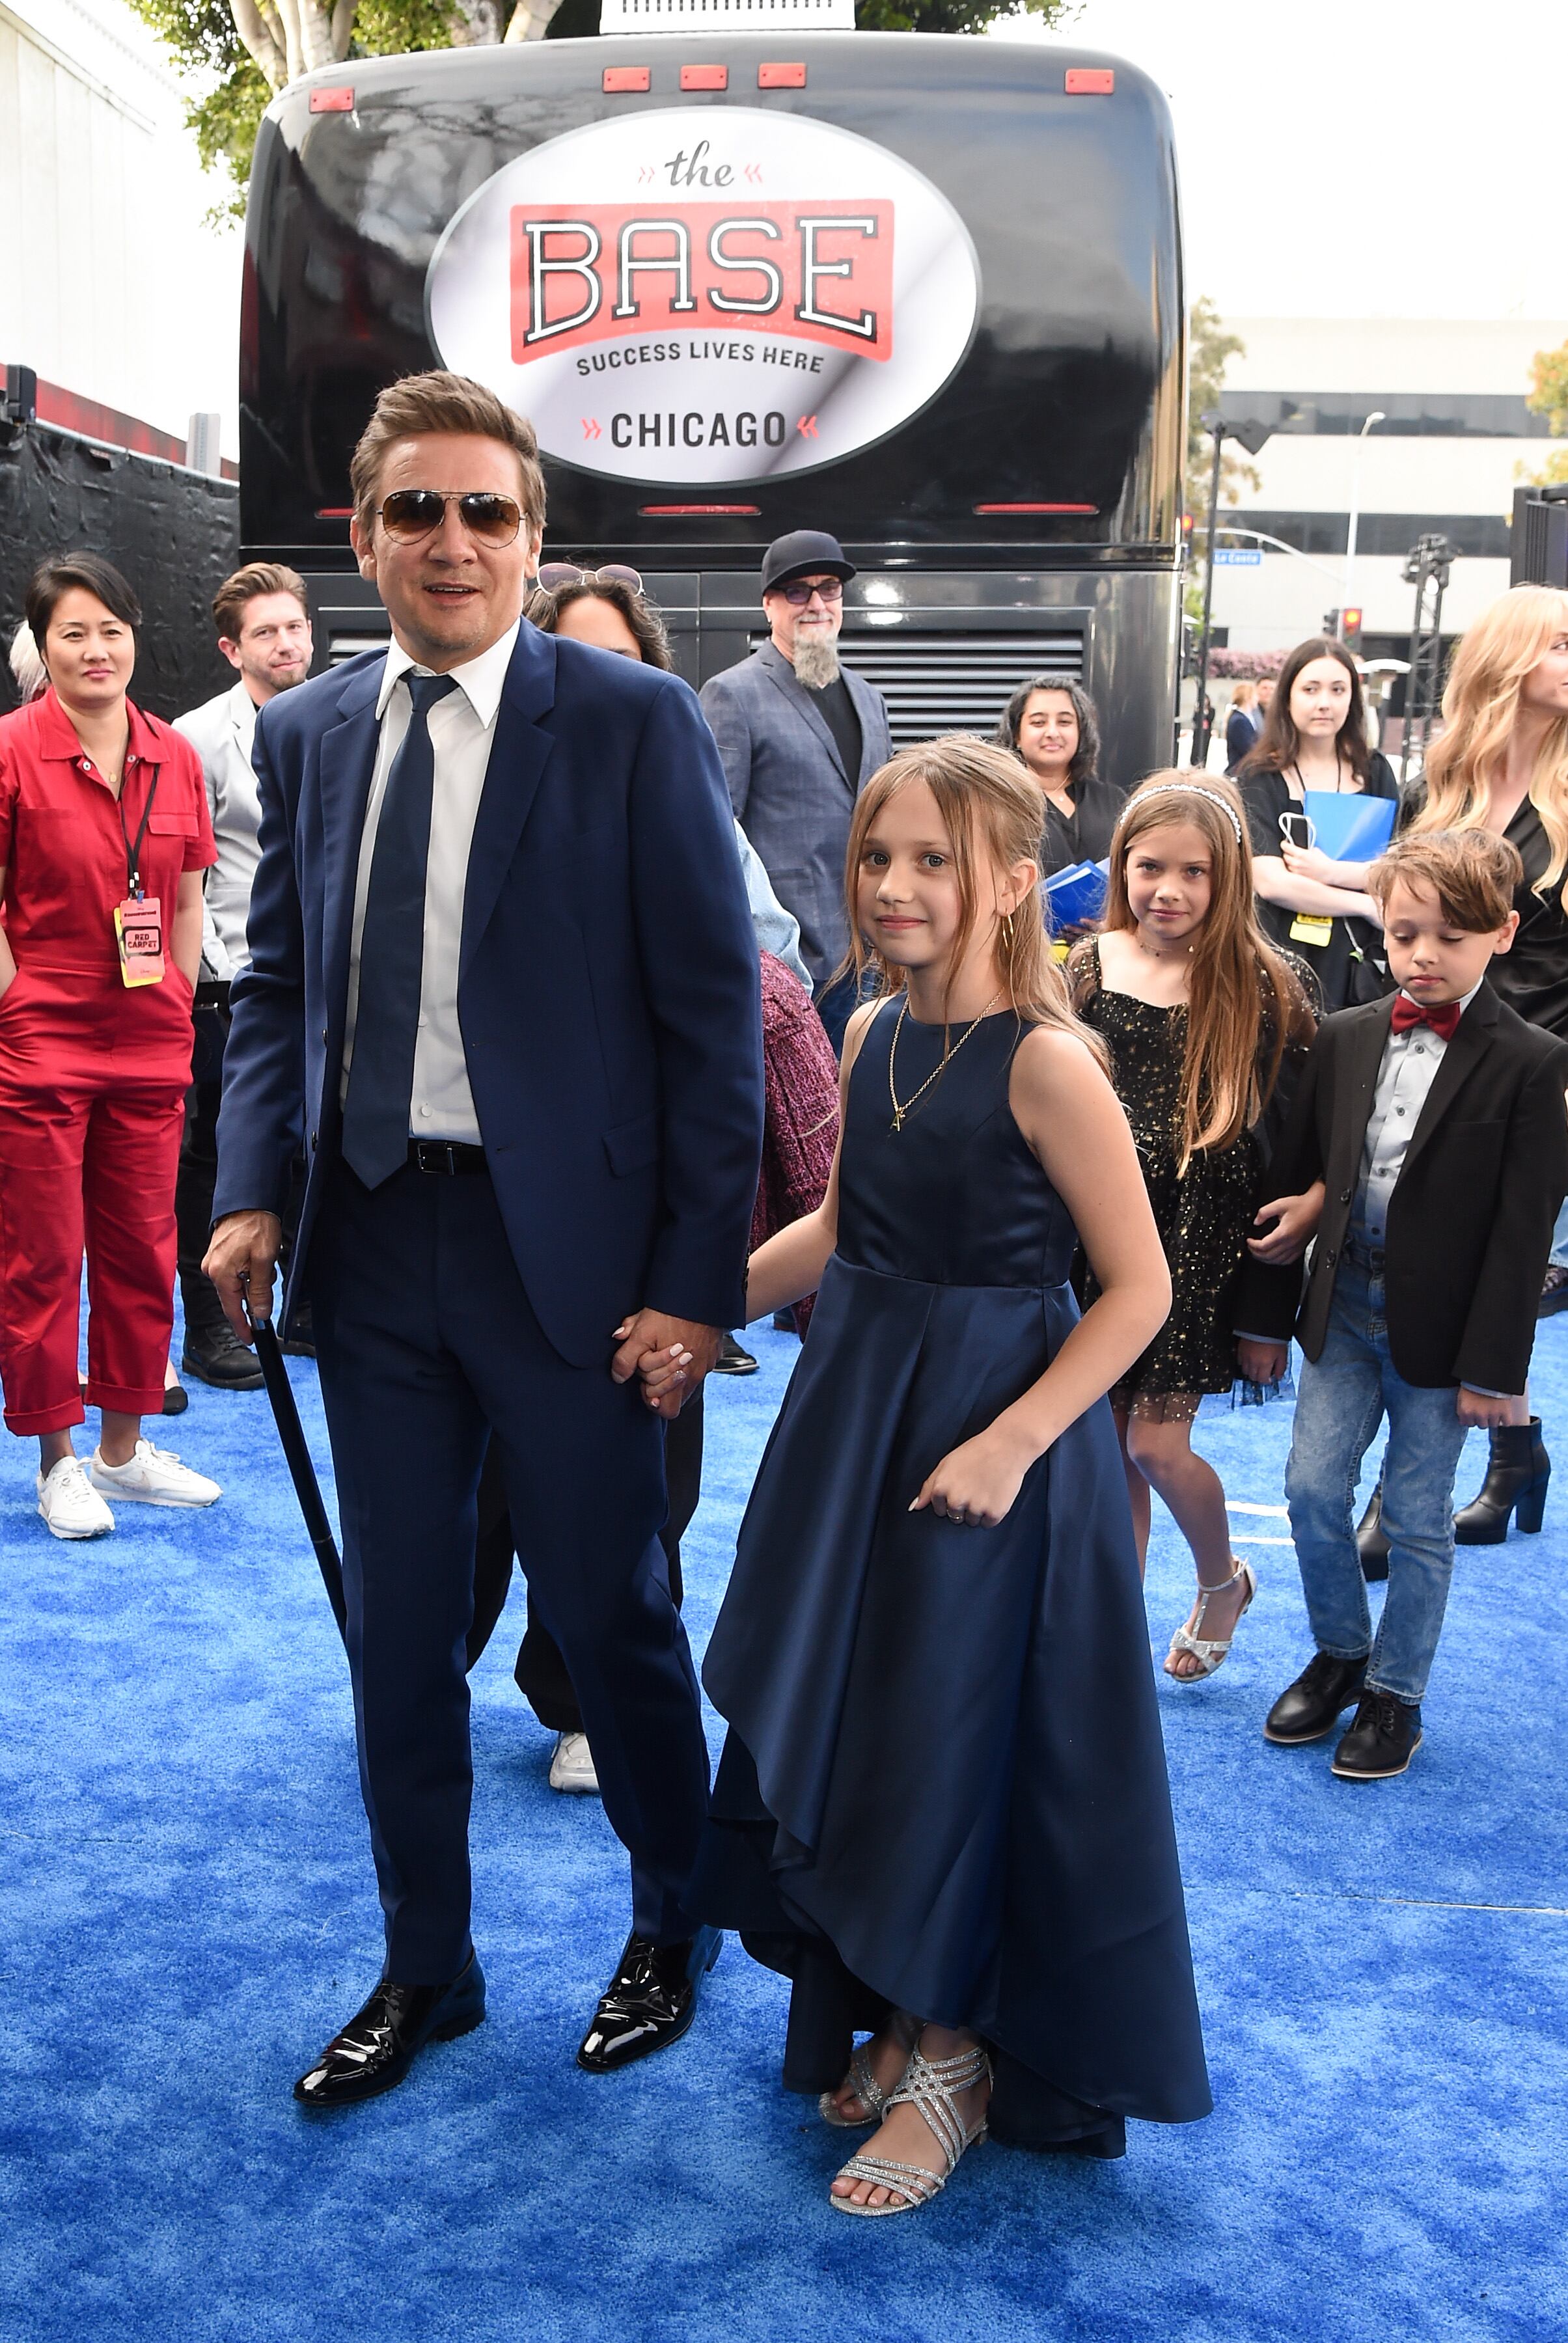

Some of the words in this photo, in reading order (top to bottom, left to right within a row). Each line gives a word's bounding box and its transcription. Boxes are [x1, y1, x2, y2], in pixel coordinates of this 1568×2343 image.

[663, 140, 735, 187] the
[523, 215, 879, 349] BASE
[576, 342, 681, 376] SUCCESS
[689, 342, 755, 361] LIVES
[762, 346, 825, 374] HERE
[611, 411, 786, 448] CHICAGO
[128, 940, 158, 948] CARPET
